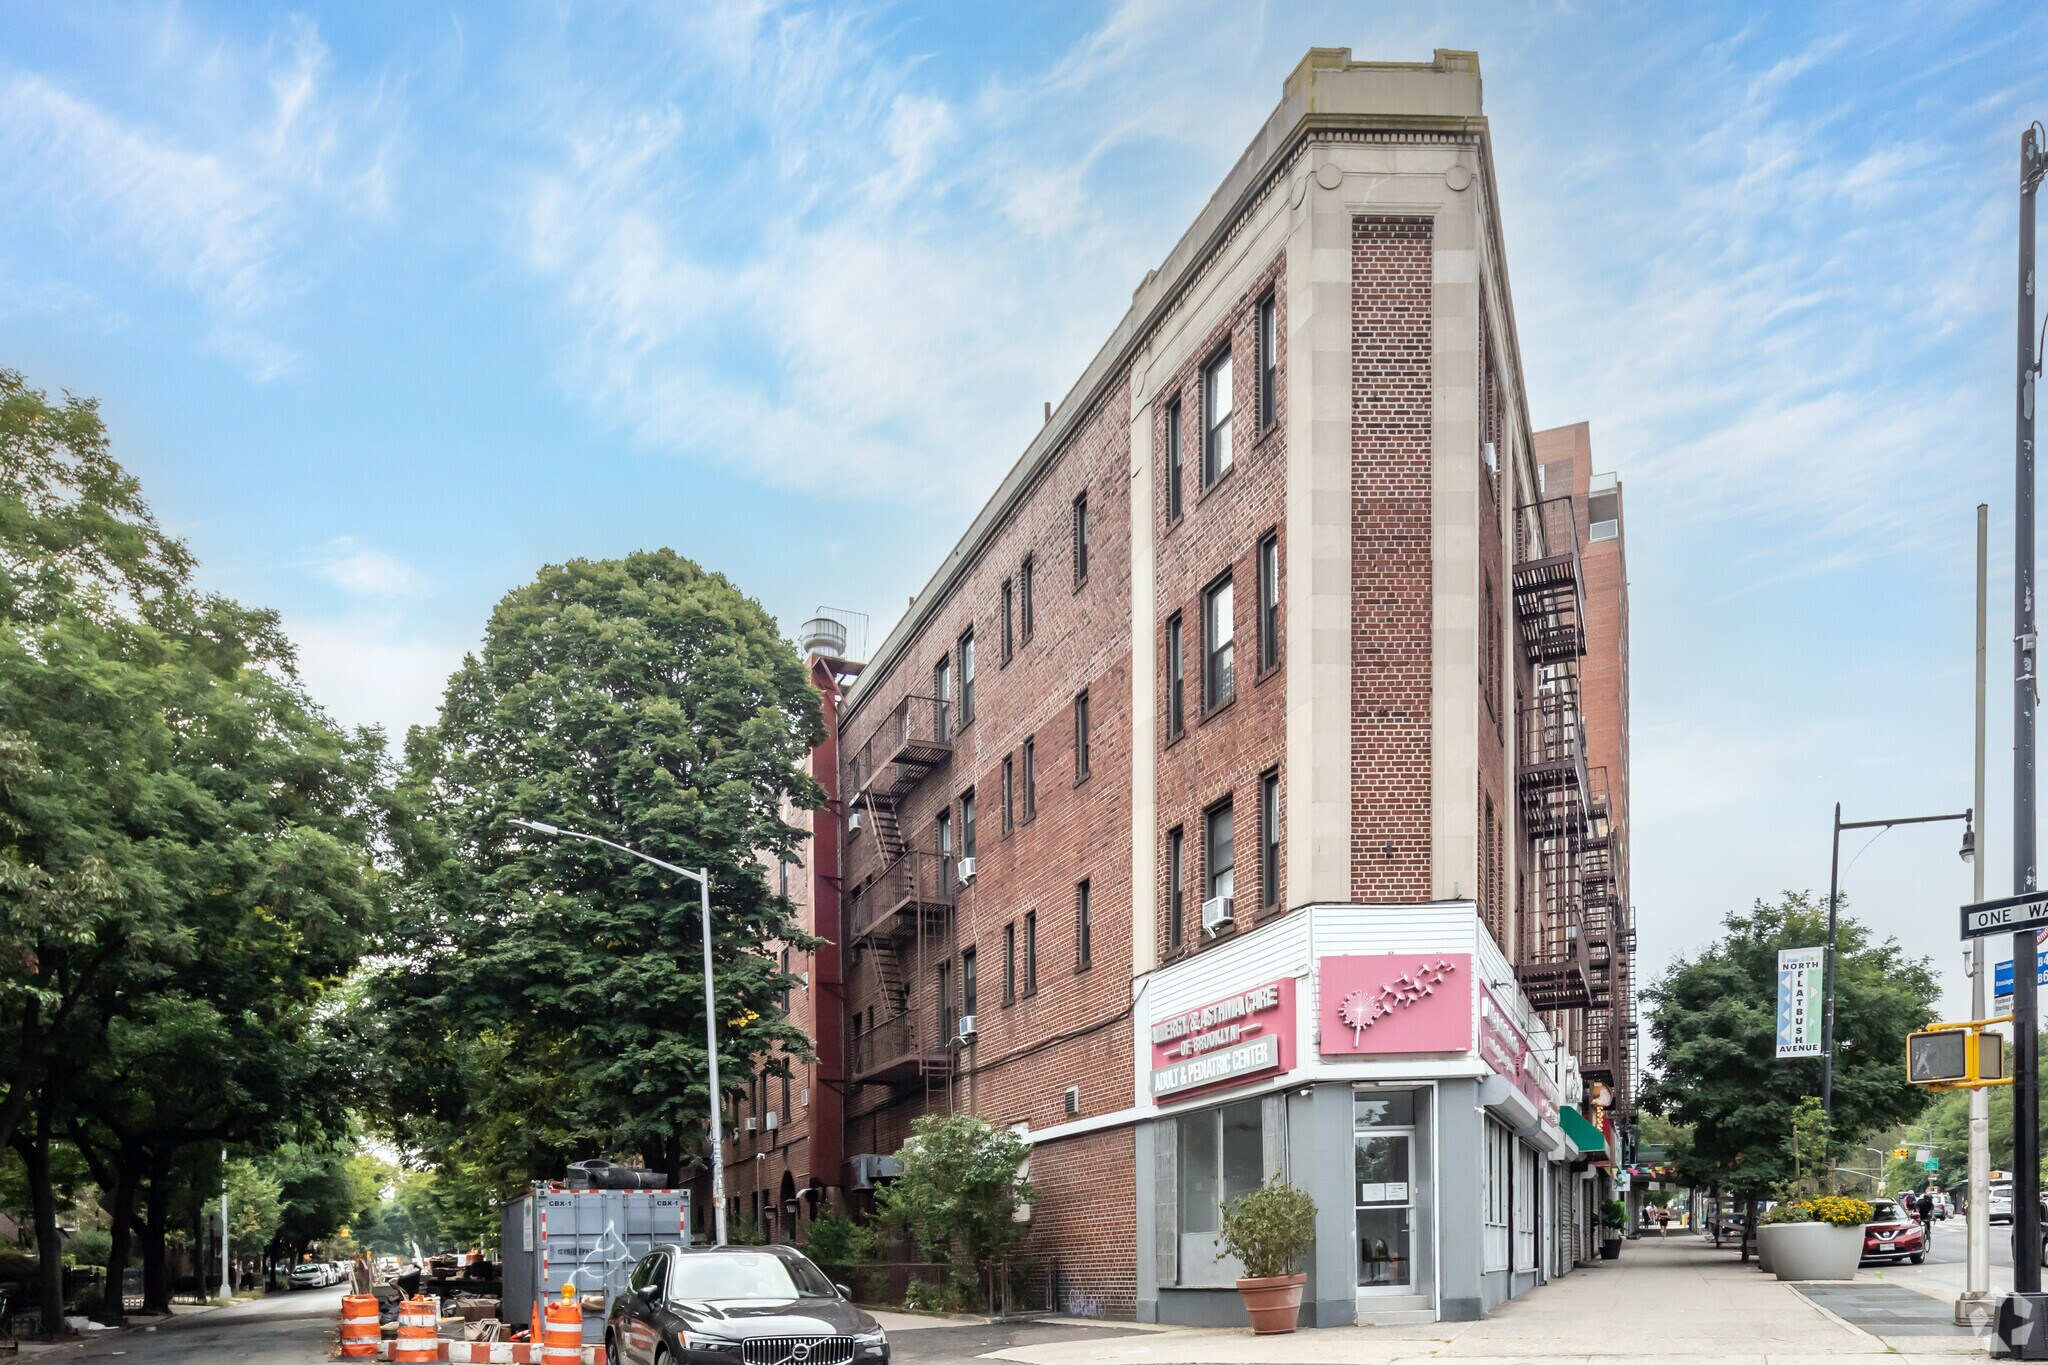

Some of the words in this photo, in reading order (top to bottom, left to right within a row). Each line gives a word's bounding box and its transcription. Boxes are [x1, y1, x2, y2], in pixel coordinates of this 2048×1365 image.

[1978, 909, 2012, 927] ONE
[1782, 962, 1819, 970] NORTH
[1151, 1015, 1190, 1044] ERGY
[1201, 996, 1246, 1027] ASTHMA
[1245, 984, 1278, 1014] CARE
[1795, 970, 1804, 1044] FLATBUSH
[1180, 1040, 1194, 1056] OF
[1193, 1024, 1240, 1052] BROOKLYN
[1779, 1044, 1818, 1053] AVENUE
[1154, 1067, 1179, 1092] ADULT
[1180, 1066, 1188, 1085] &
[1187, 1052, 1231, 1083] PEDIATRIC
[1232, 1042, 1268, 1071] CENTER
